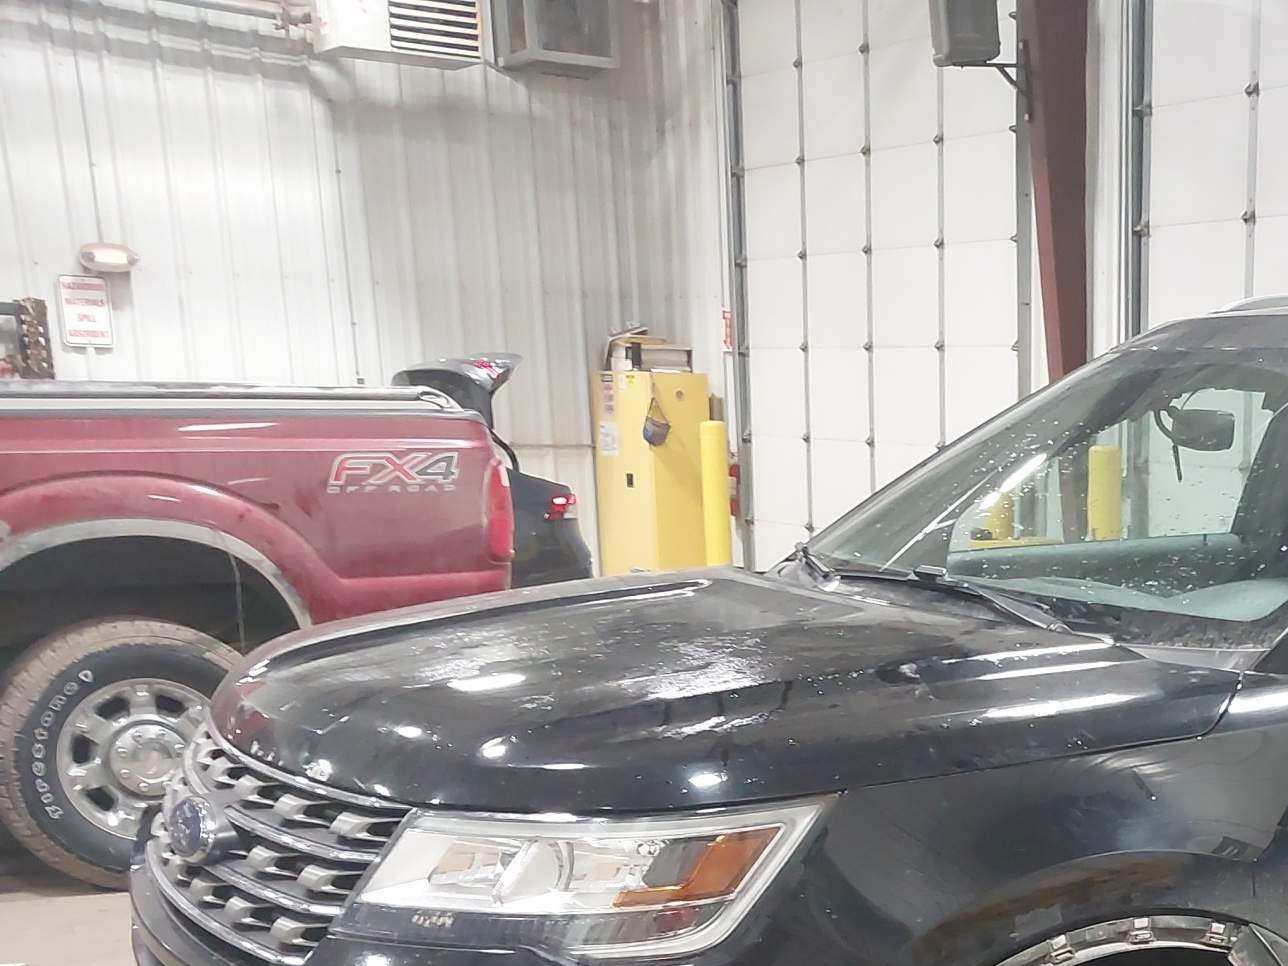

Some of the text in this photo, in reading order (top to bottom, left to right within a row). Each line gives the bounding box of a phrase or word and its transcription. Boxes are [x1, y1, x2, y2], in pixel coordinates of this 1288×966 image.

[328, 452, 459, 485] FX4
[326, 484, 457, 494] OFF ROAD
[32, 682, 79, 819] Firestone
